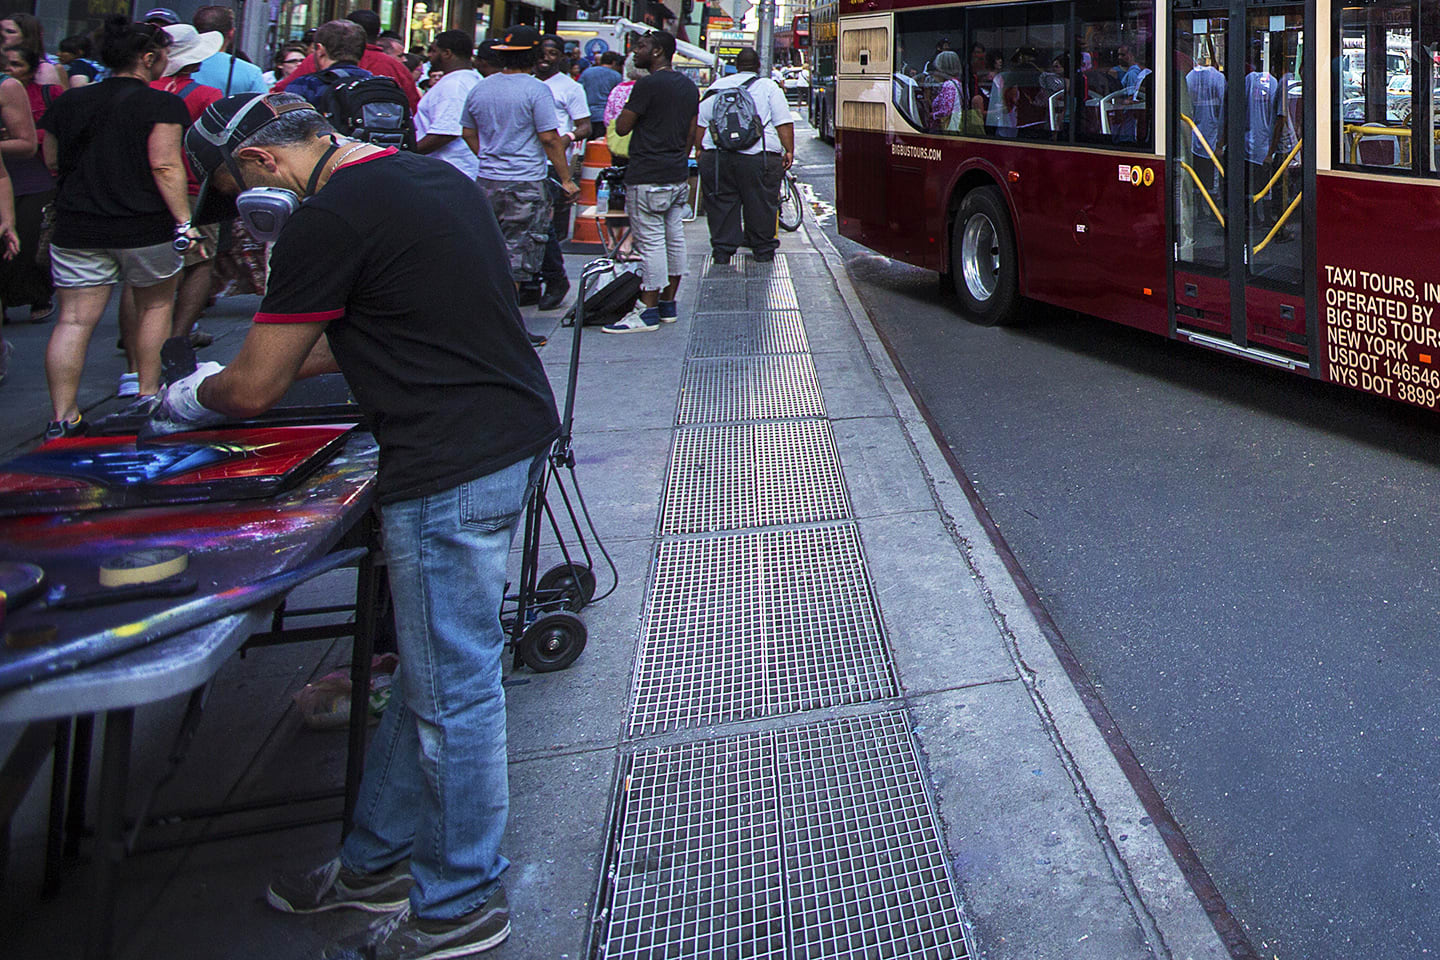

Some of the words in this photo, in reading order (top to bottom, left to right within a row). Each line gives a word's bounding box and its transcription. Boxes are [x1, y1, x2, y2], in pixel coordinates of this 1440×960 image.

[891, 142, 942, 161] BIGBUSTOURS.COM
[1325, 265, 1356, 288] TAXI
[1360, 271, 1420, 303] TOURS,
[1326, 288, 1407, 320] OPERATED
[1412, 304, 1434, 326] BY
[1326, 307, 1352, 328] BIG
[1356, 313, 1387, 336] BUS
[1327, 326, 1361, 350] NEW
[1364, 334, 1409, 362] YORK
[1328, 344, 1379, 373] USDOT
[1329, 363, 1358, 387] NYS
[1362, 372, 1394, 396] DOT
